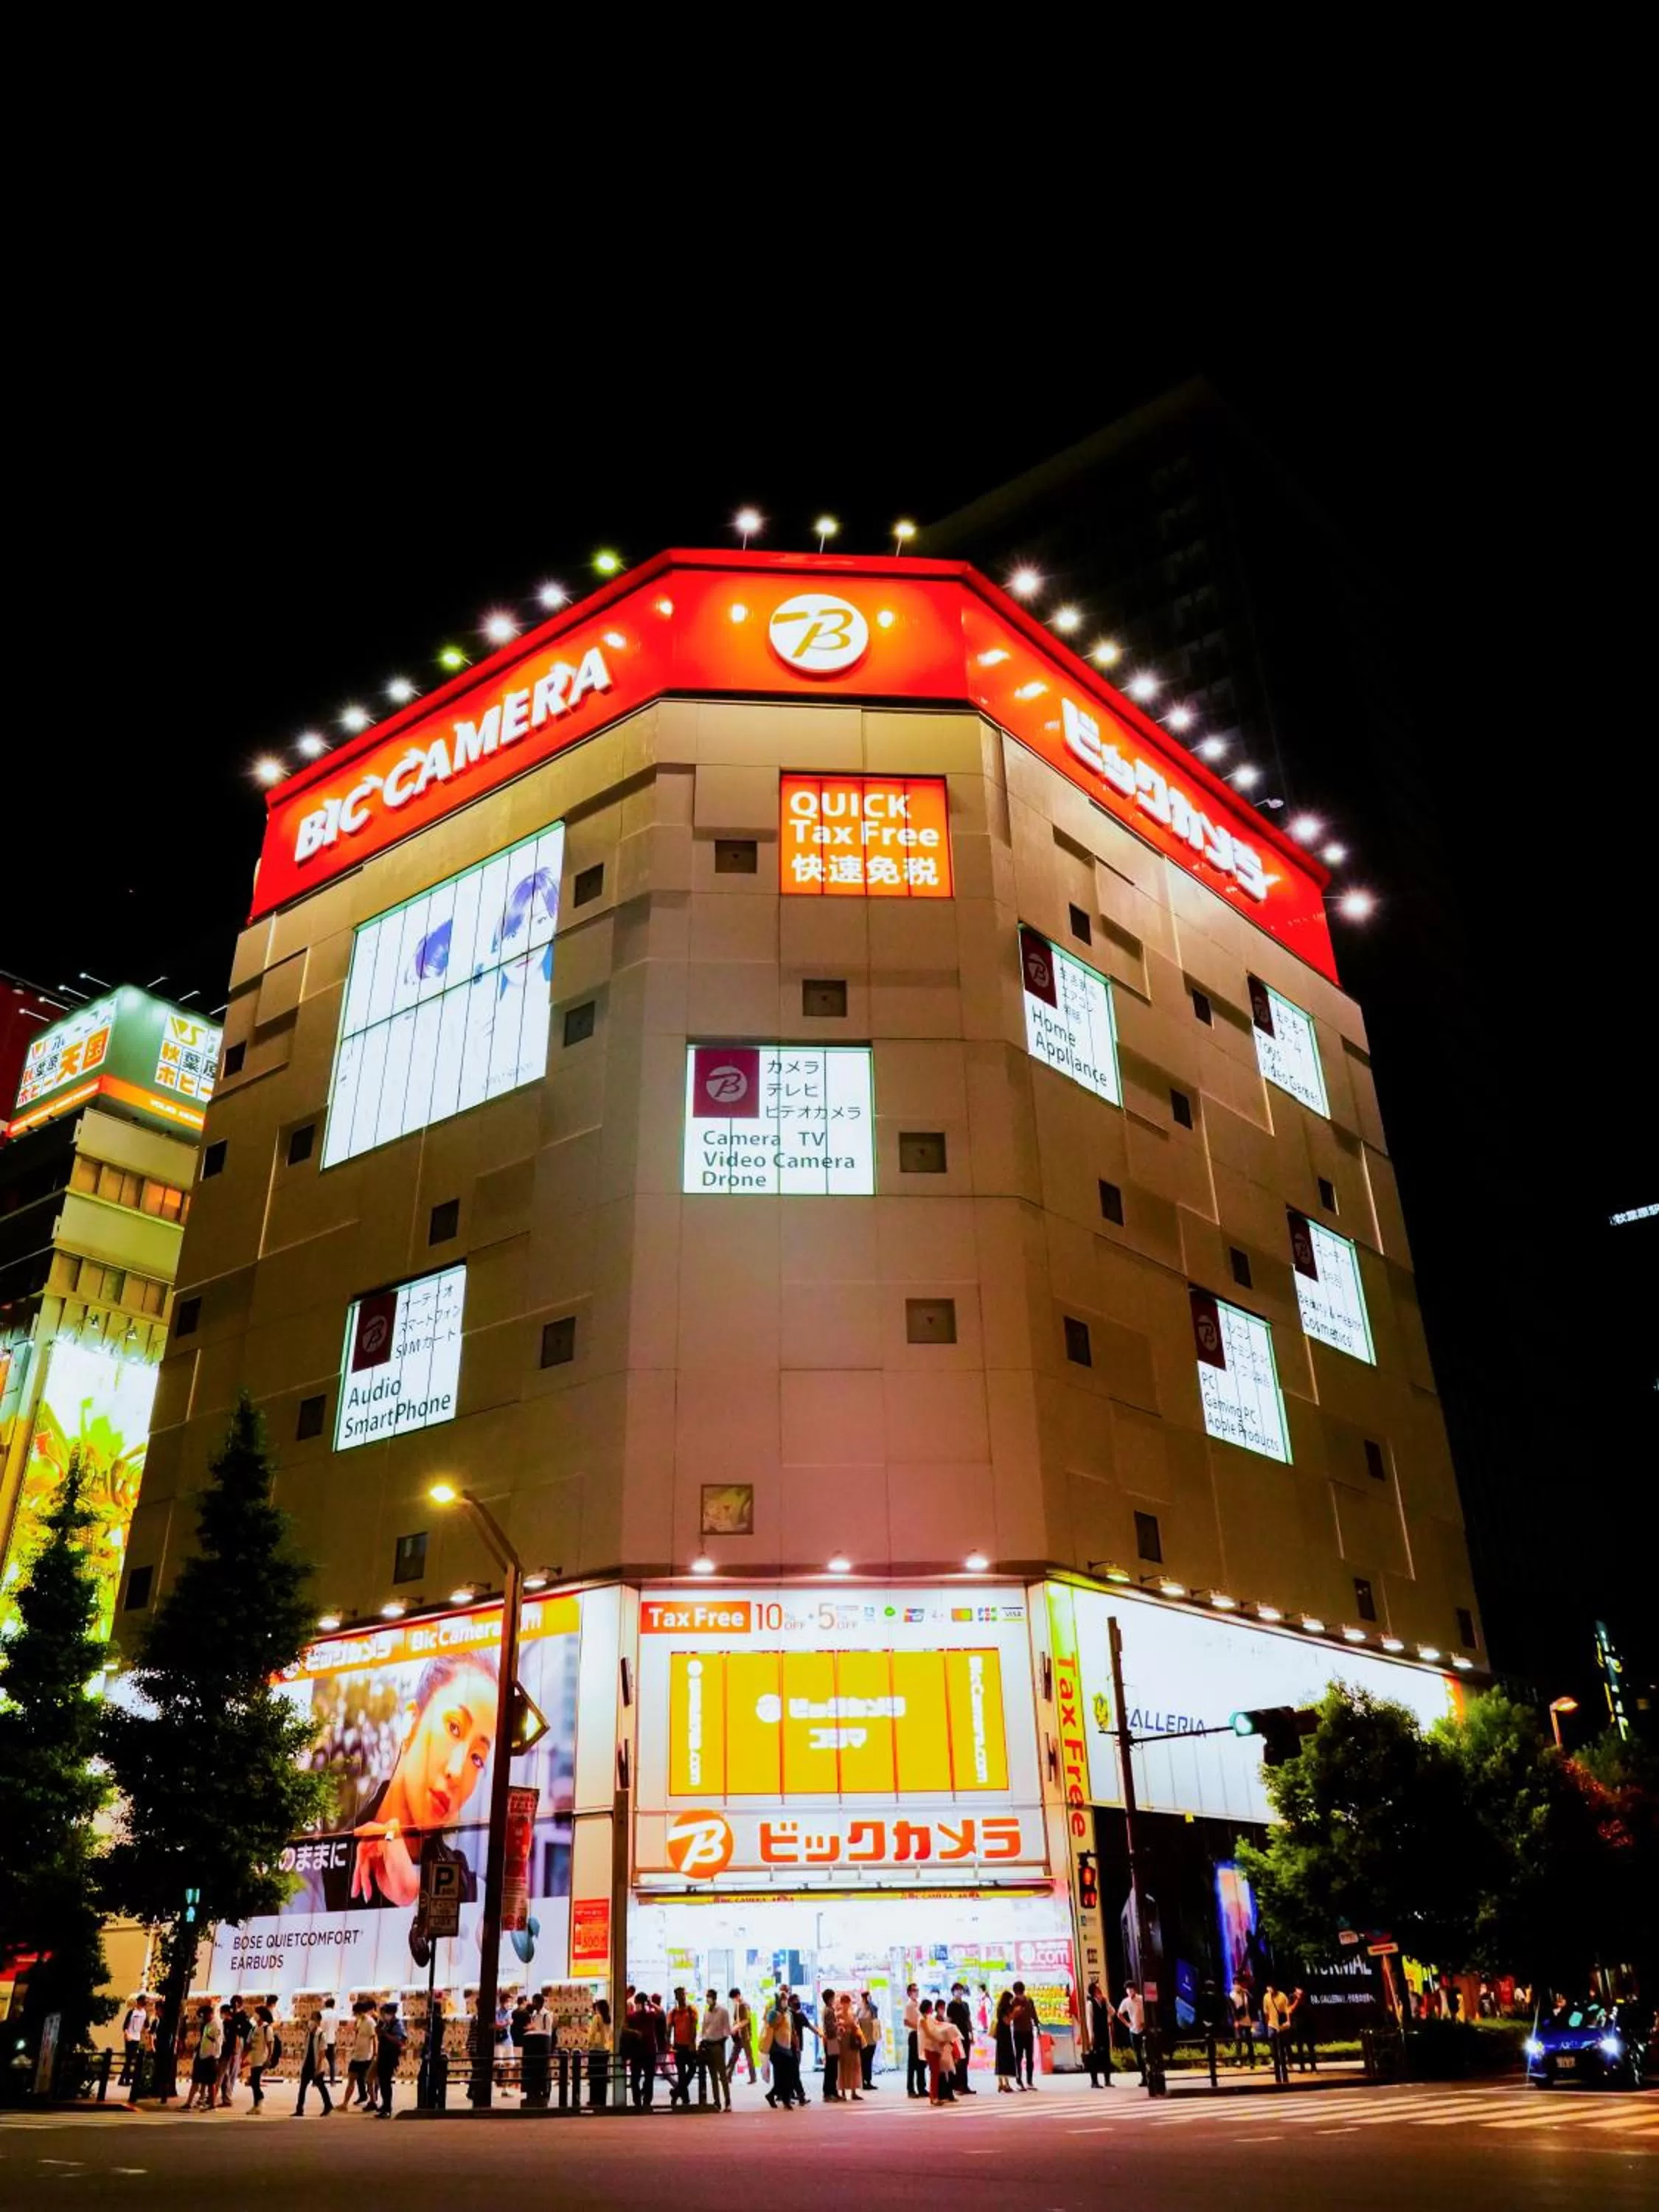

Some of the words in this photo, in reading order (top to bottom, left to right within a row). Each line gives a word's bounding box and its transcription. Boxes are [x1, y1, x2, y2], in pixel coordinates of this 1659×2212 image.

[295, 776, 382, 862] BIC
[383, 647, 611, 807] CAMERA
[790, 791, 912, 819] QUICK
[1062, 698, 1270, 901] ビックカメラ
[789, 820, 853, 845] Tax
[860, 821, 939, 846] Free
[792, 853, 939, 886] 快速免税
[1032, 1005, 1076, 1047] Home
[767, 1060, 819, 1074] カメラ
[1035, 1032, 1107, 1087] Appliance
[703, 1130, 780, 1146] Camera
[799, 1132, 825, 1146] TV
[703, 1152, 766, 1167] Video
[773, 1152, 855, 1169] Camera
[703, 1171, 766, 1187] Drone
[348, 1377, 401, 1409] Audio
[344, 1394, 451, 1438] SmartPhone
[649, 1607, 689, 1627] Tax
[695, 1607, 744, 1628] Free
[1057, 1651, 1077, 1727] Tax
[1127, 1708, 1207, 1739] ALLERIA
[1064, 1738, 1086, 1838] Free
[759, 1818, 1022, 1863] ビックカメラ
[278, 1842, 347, 1872] のままに
[435, 1866, 454, 1895] P
[233, 1935, 263, 1950] BOSE
[266, 1930, 359, 1949] QUIETCOMFORT
[231, 1955, 284, 1970] EARBUDS
